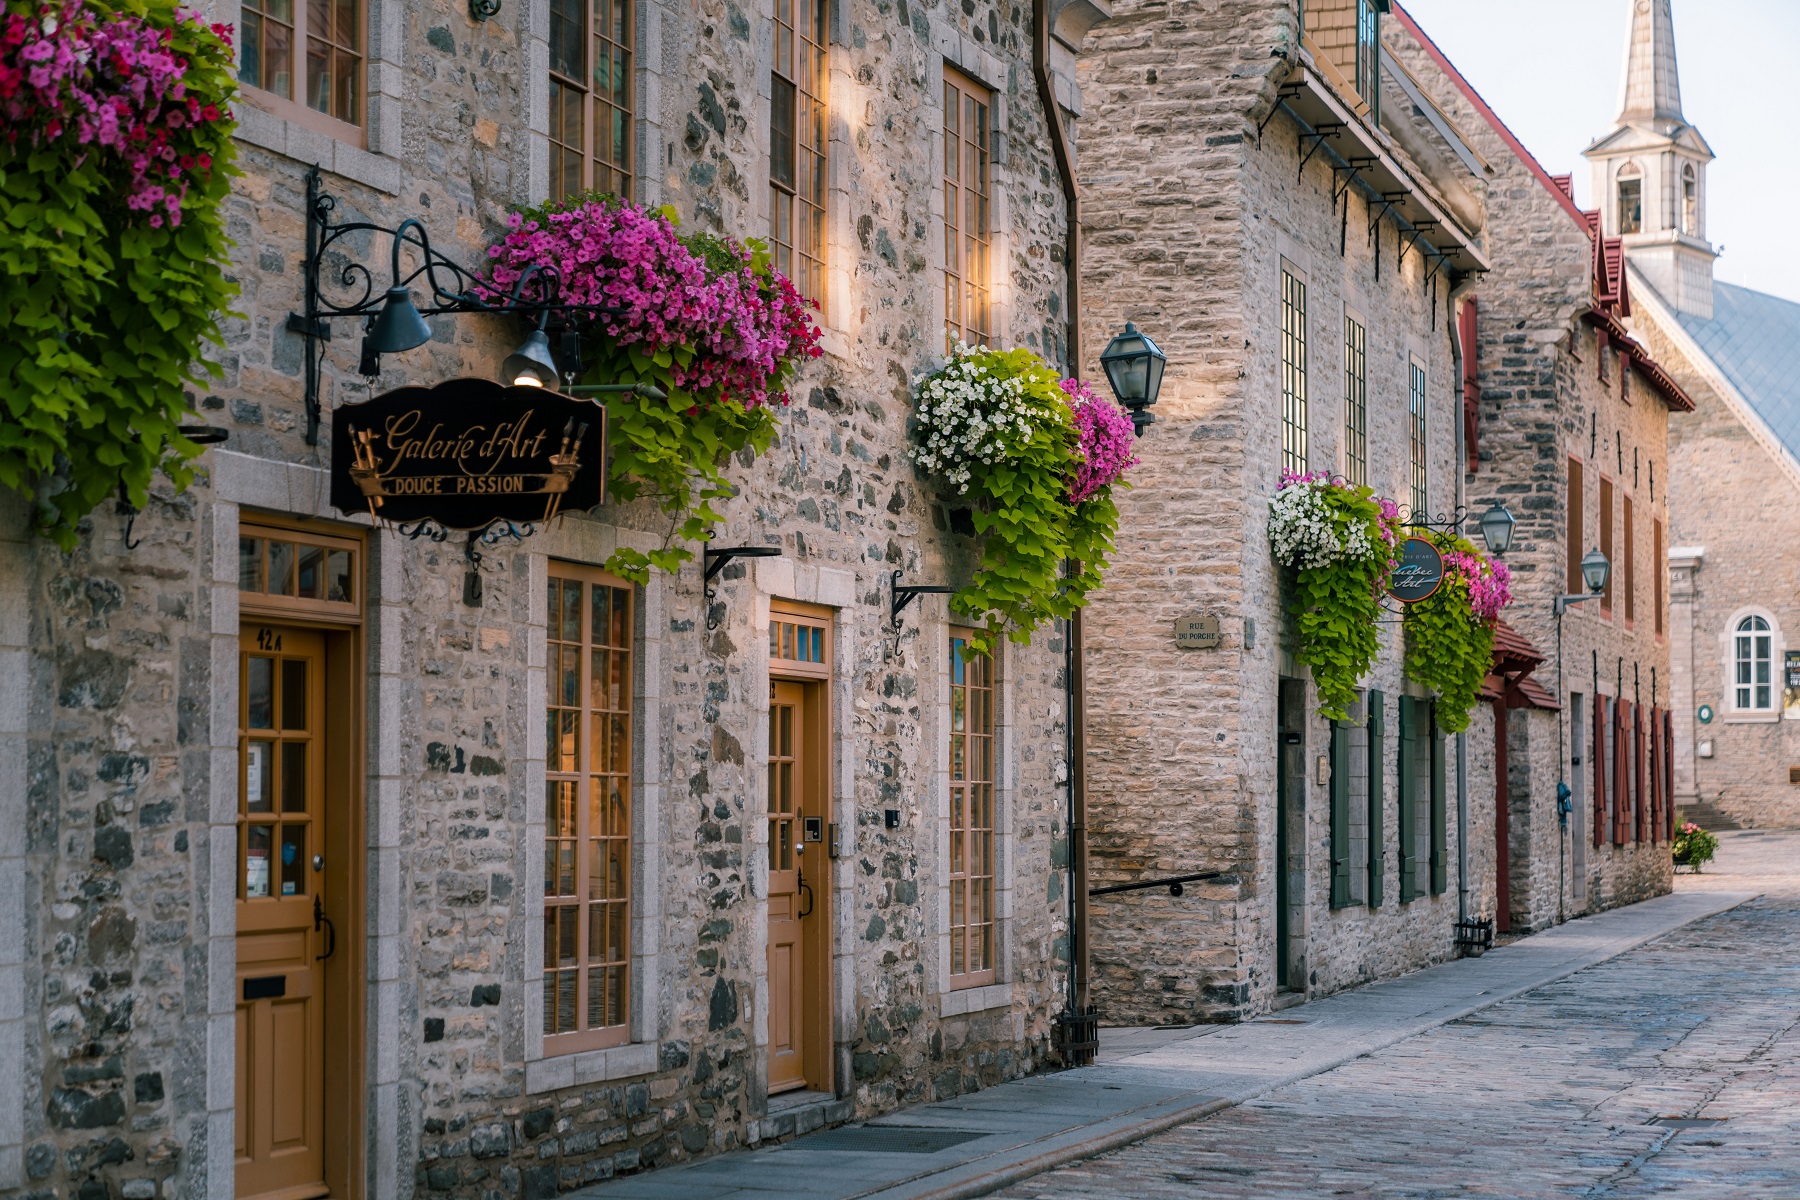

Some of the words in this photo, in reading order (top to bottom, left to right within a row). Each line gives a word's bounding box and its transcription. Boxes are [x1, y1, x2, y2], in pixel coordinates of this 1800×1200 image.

[378, 409, 486, 476] Galerie
[477, 408, 547, 475] d'Art
[456, 475, 523, 494] PASSION
